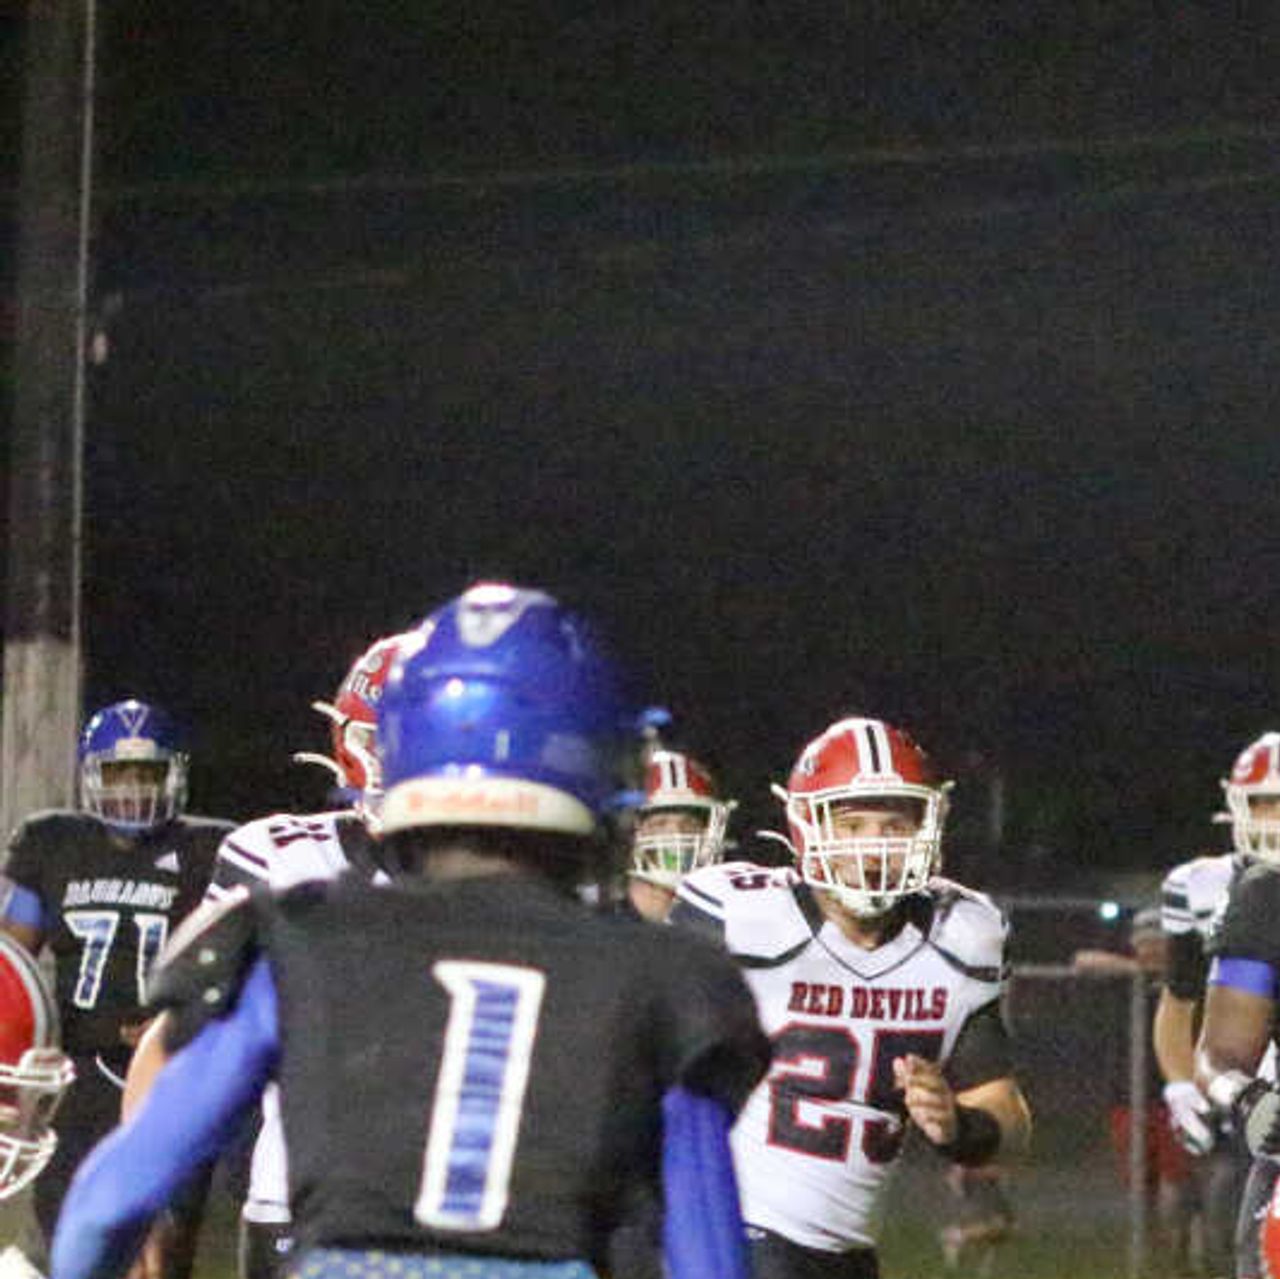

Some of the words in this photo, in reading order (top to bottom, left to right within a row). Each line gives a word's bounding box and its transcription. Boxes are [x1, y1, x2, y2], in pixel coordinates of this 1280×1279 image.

[62, 909, 169, 1010] 71
[787, 981, 844, 1018] RED
[850, 984, 949, 1021] DEVILS
[414, 958, 547, 1232] 1
[766, 1020, 947, 1165] 25
